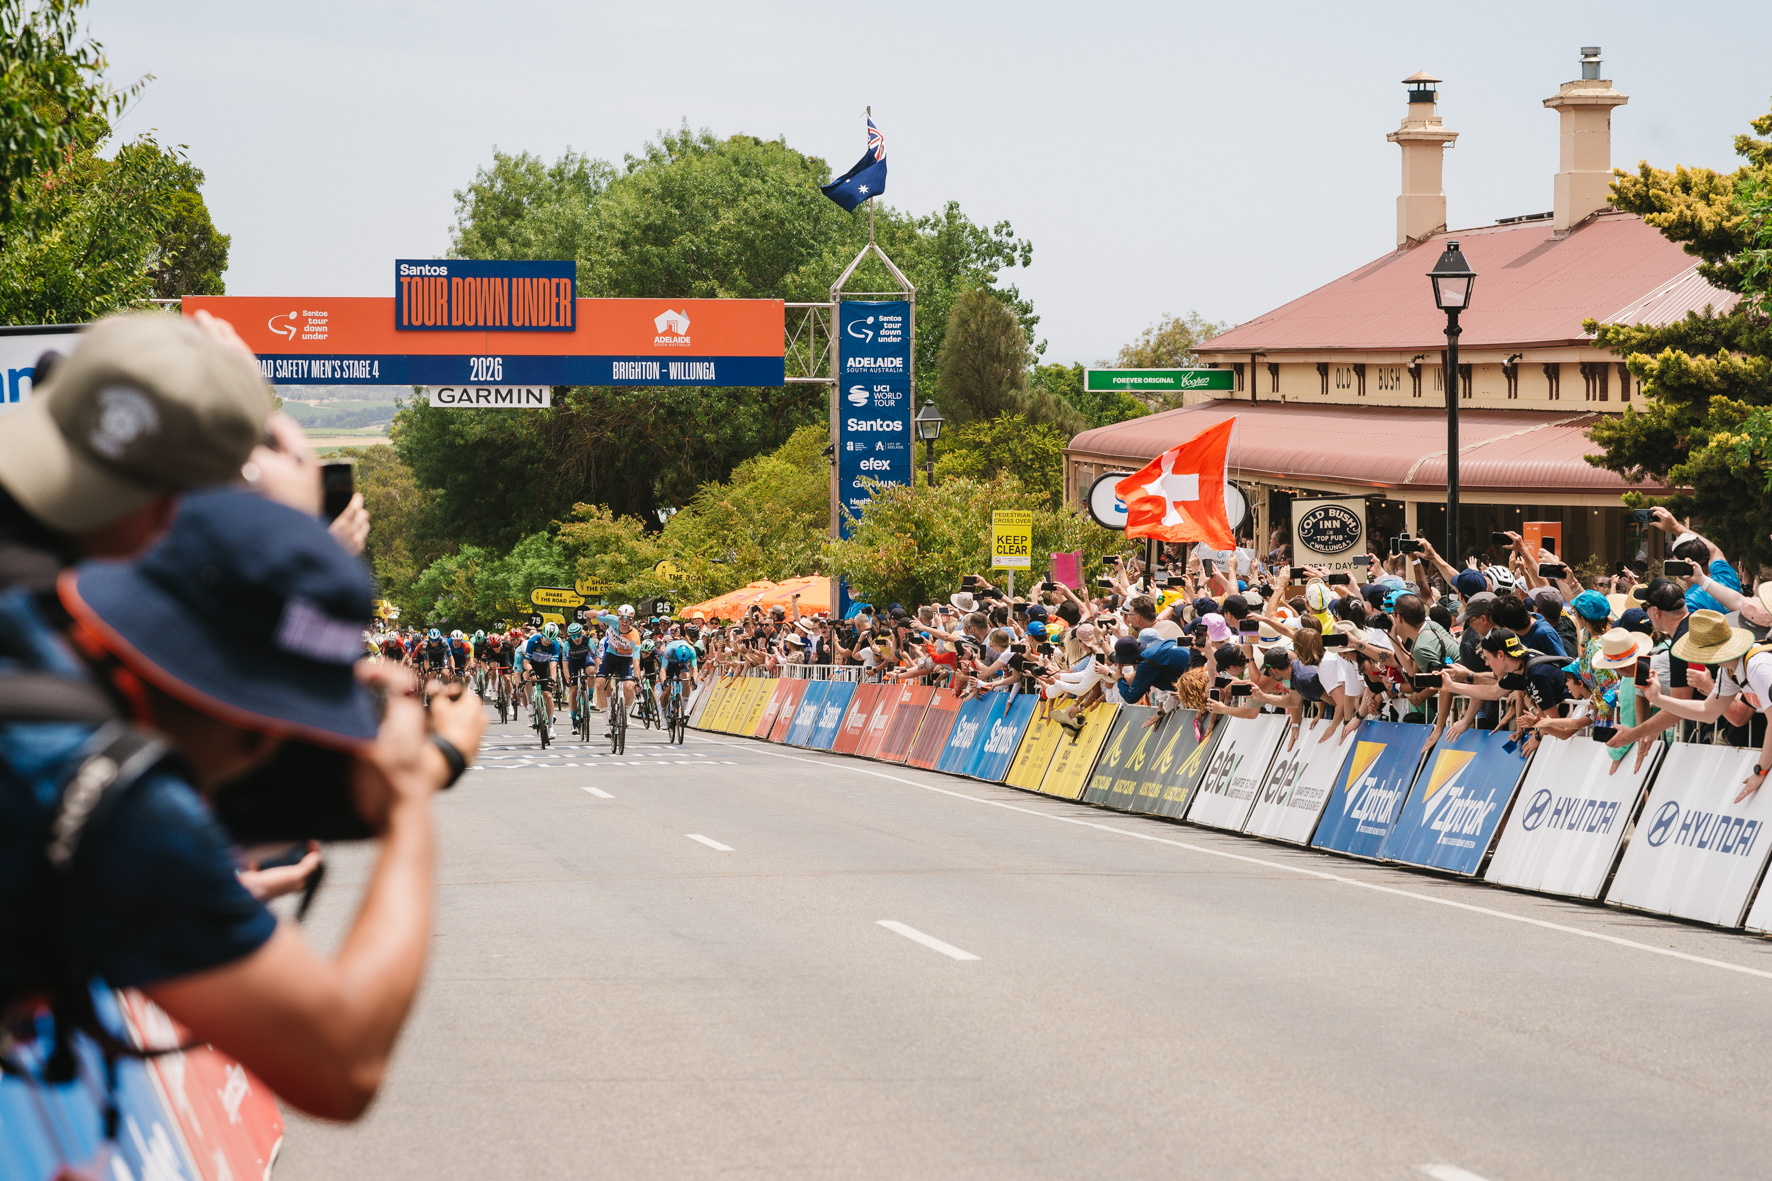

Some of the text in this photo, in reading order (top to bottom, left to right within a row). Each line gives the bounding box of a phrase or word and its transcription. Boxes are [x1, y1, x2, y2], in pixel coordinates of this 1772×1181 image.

[400, 263, 448, 276] Santos
[400, 276, 572, 328] TOUR DOWN UNDER
[654, 336, 691, 344] ADELAIDE
[276, 359, 309, 378] SAFETY
[311, 359, 341, 379] MEN’S
[342, 360, 371, 379] STAGE
[372, 360, 380, 379] 4
[470, 357, 503, 381] 2026
[612, 361, 660, 380] BRIGHTON
[669, 361, 716, 380] WILLUNGA
[846, 357, 903, 368] ADELAIDE
[1181, 371, 1210, 389] Coopers
[1335, 367, 1352, 389] OLD
[1378, 367, 1401, 391] BUSH
[437, 387, 543, 404] GARMIN
[873, 399, 896, 407] TOUR
[847, 417, 903, 432] Santos
[860, 457, 891, 471] efex
[1303, 509, 1357, 529] OLD BUSH
[1319, 520, 1340, 529] INN
[996, 535, 1028, 545] KEEP
[1314, 541, 1348, 551] WILLUNGA
[996, 544, 1028, 555] CLEAR
[656, 602, 671, 613] 25
[531, 617, 541, 625] 75
[984, 717, 1018, 755] Santos
[1204, 740, 1245, 797] efex
[1263, 748, 1309, 807] efex
[1350, 776, 1401, 832] Ziptrak
[1430, 786, 1495, 844] Ziptrak
[1547, 796, 1622, 834] HYUNDAI
[1674, 809, 1763, 857] HYUNDAI
